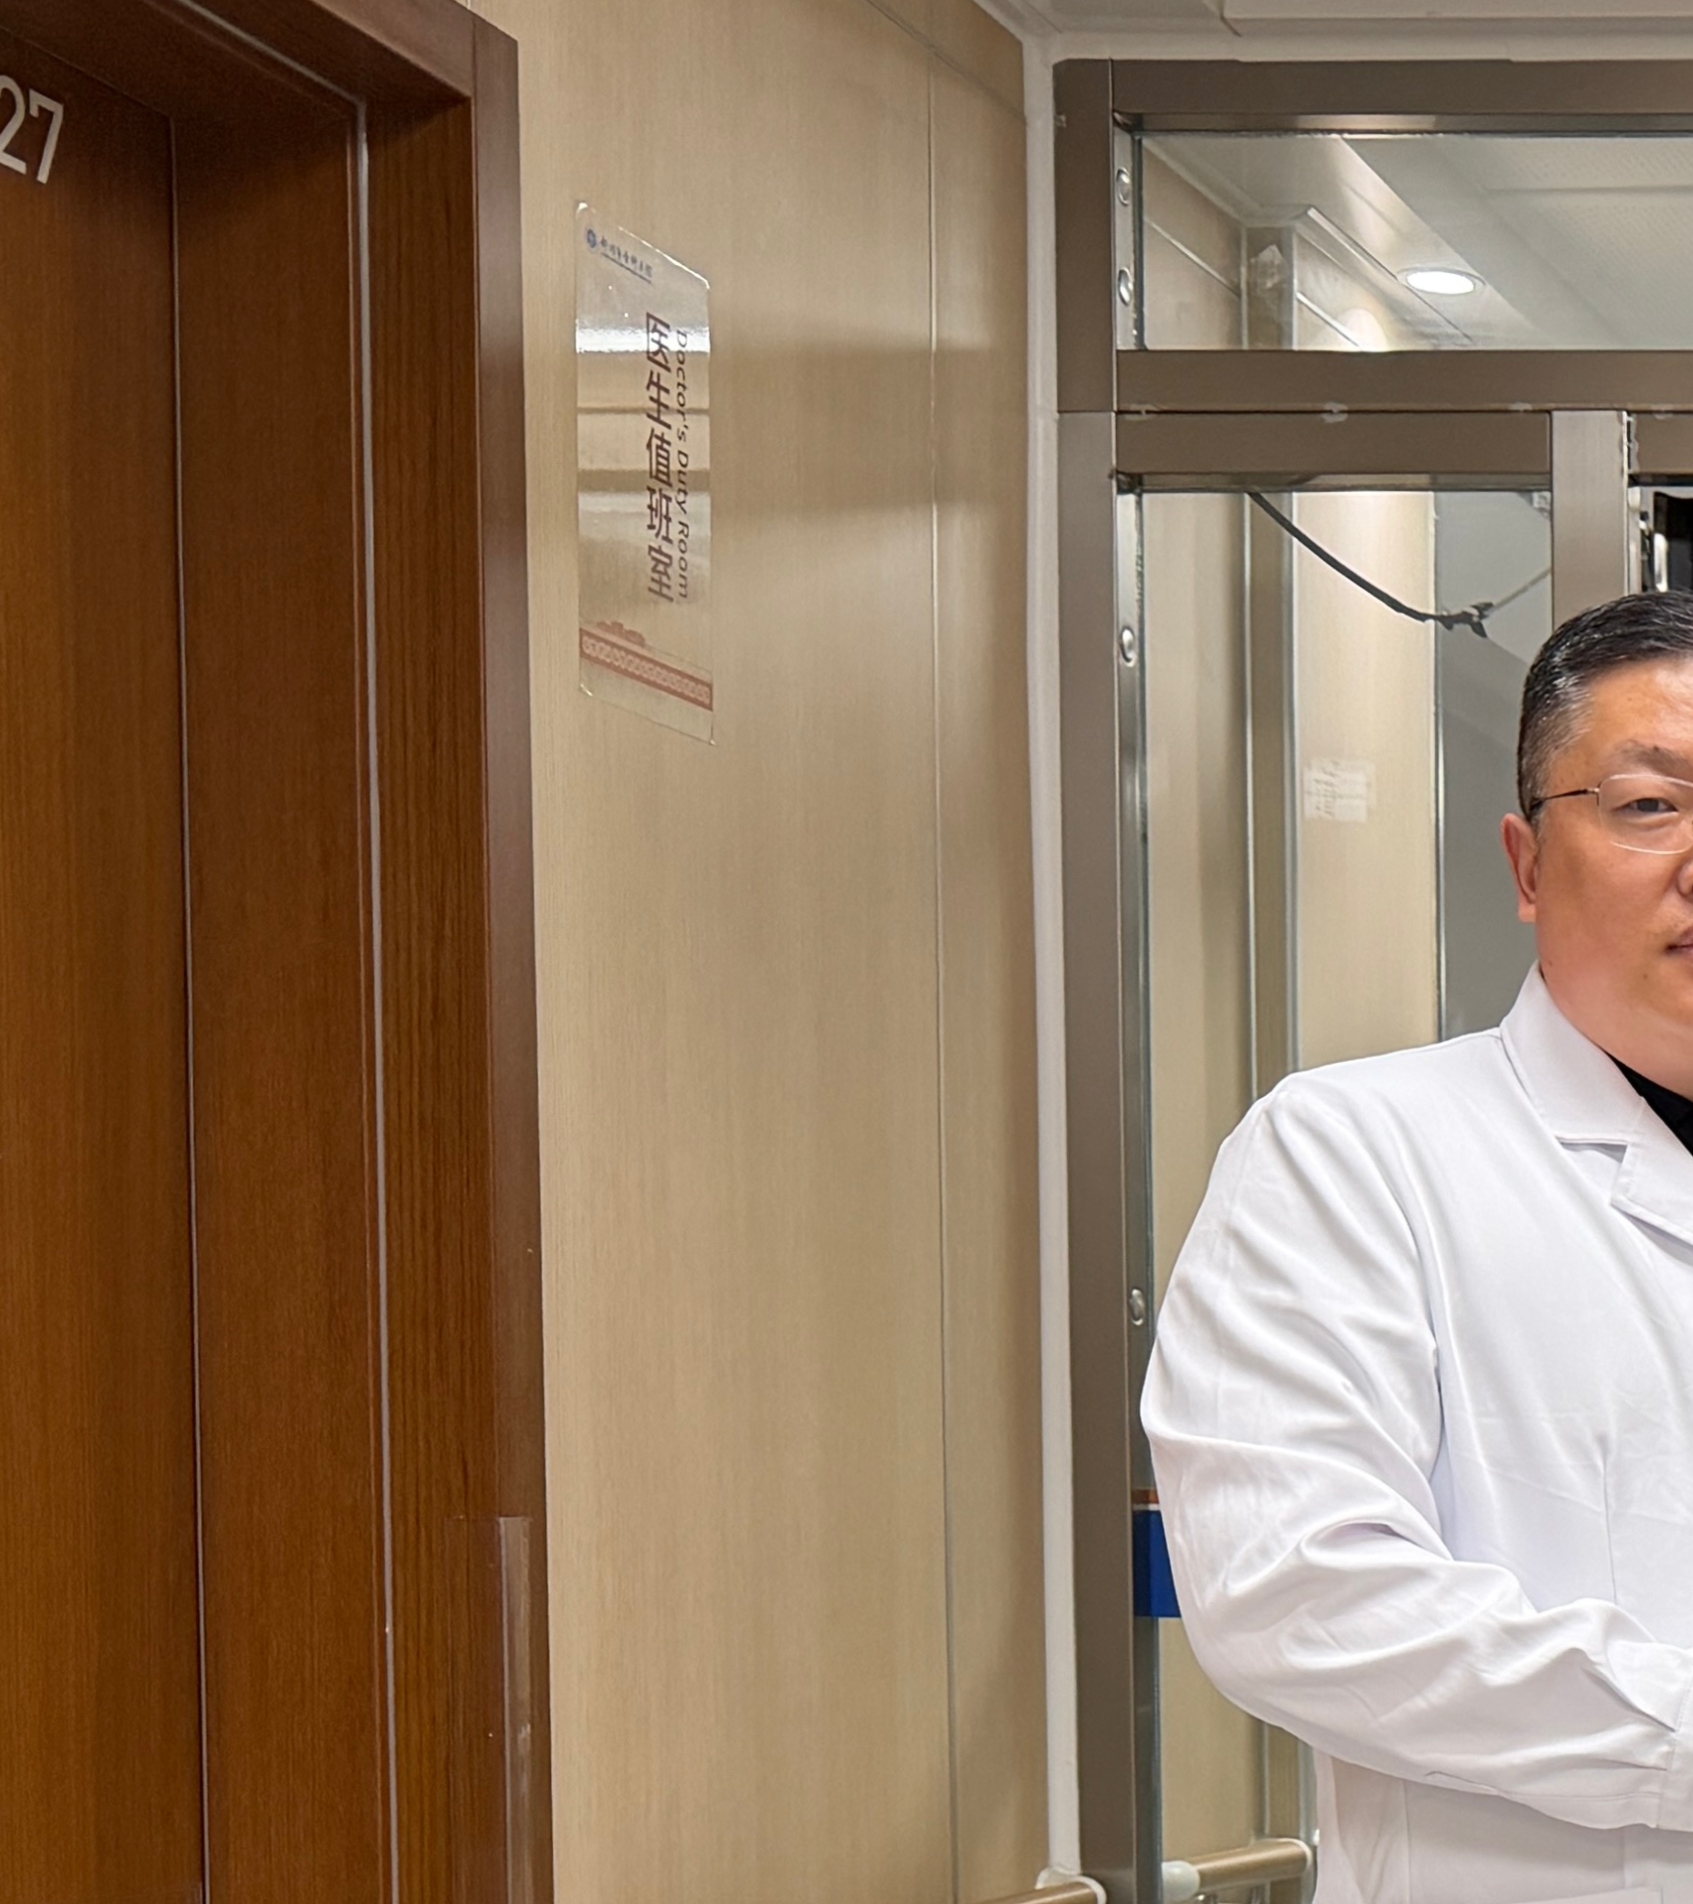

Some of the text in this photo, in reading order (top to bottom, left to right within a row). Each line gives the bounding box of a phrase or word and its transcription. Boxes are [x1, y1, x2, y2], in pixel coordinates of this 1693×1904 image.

[646, 312, 674, 603] 医生值班室
[675, 328, 690, 599] Doctor's Duty Room
